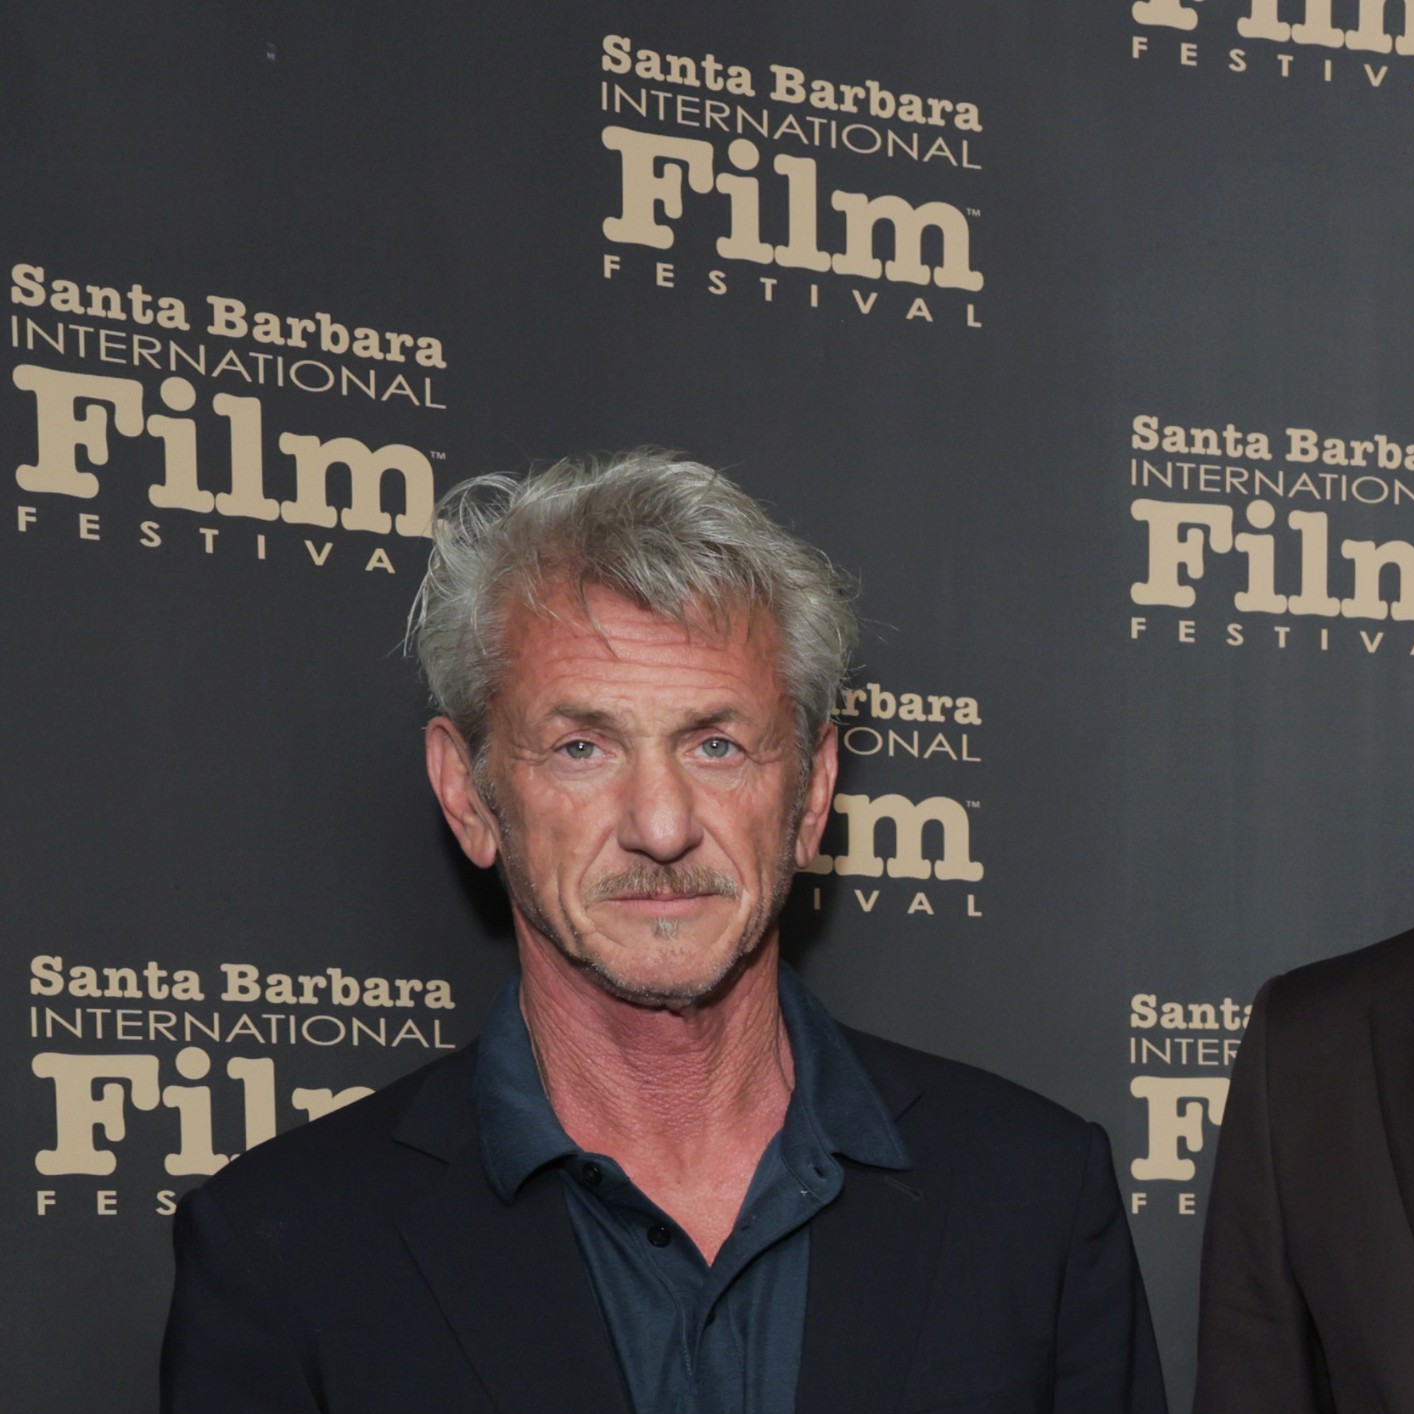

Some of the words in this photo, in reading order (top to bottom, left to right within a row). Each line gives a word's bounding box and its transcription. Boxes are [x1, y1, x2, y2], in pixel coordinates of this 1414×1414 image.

[602, 35, 755, 96] Santa
[770, 65, 982, 132] Barbara
[602, 82, 982, 170] INTERNATIONAL
[602, 126, 983, 291] Film
[12, 264, 190, 330] Santa
[207, 296, 446, 368] Barbara
[604, 255, 981, 327] FESTIVAL
[12, 312, 446, 411] INTERNATIONAL
[12, 364, 449, 540] Film
[1132, 415, 1272, 460] Santa
[18, 506, 395, 573] FESTIVA
[832, 683, 982, 725] rbara
[31, 956, 204, 1000] Santa
[221, 964, 455, 1009] Barbara
[31, 1007, 455, 1048] INTERNATIONAL
